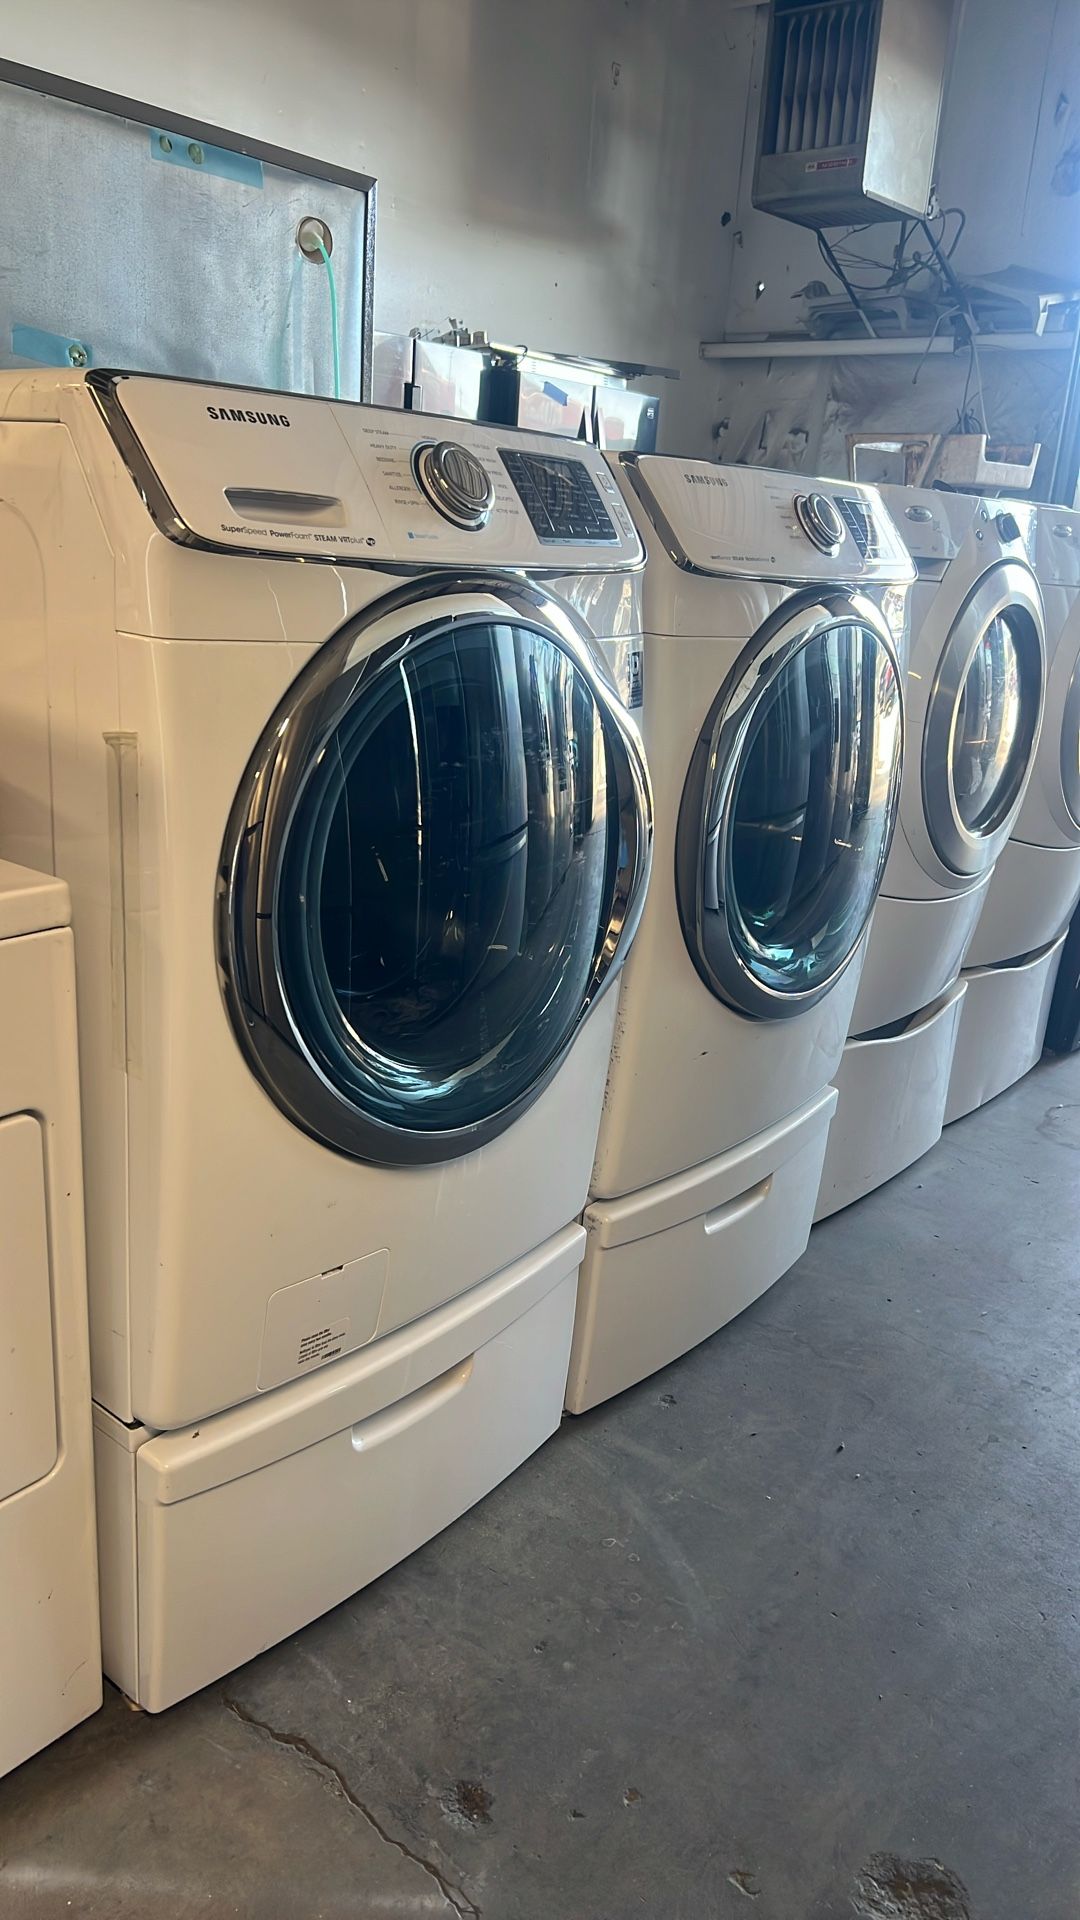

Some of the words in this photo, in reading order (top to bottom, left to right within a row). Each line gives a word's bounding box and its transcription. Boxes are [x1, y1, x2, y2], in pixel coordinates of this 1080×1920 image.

[206, 406, 291, 428] SAMSUNG
[683, 473, 729, 487] SAMSUNG
[220, 523, 268, 536] SuperSpeed
[313, 533, 338, 543] STEAM
